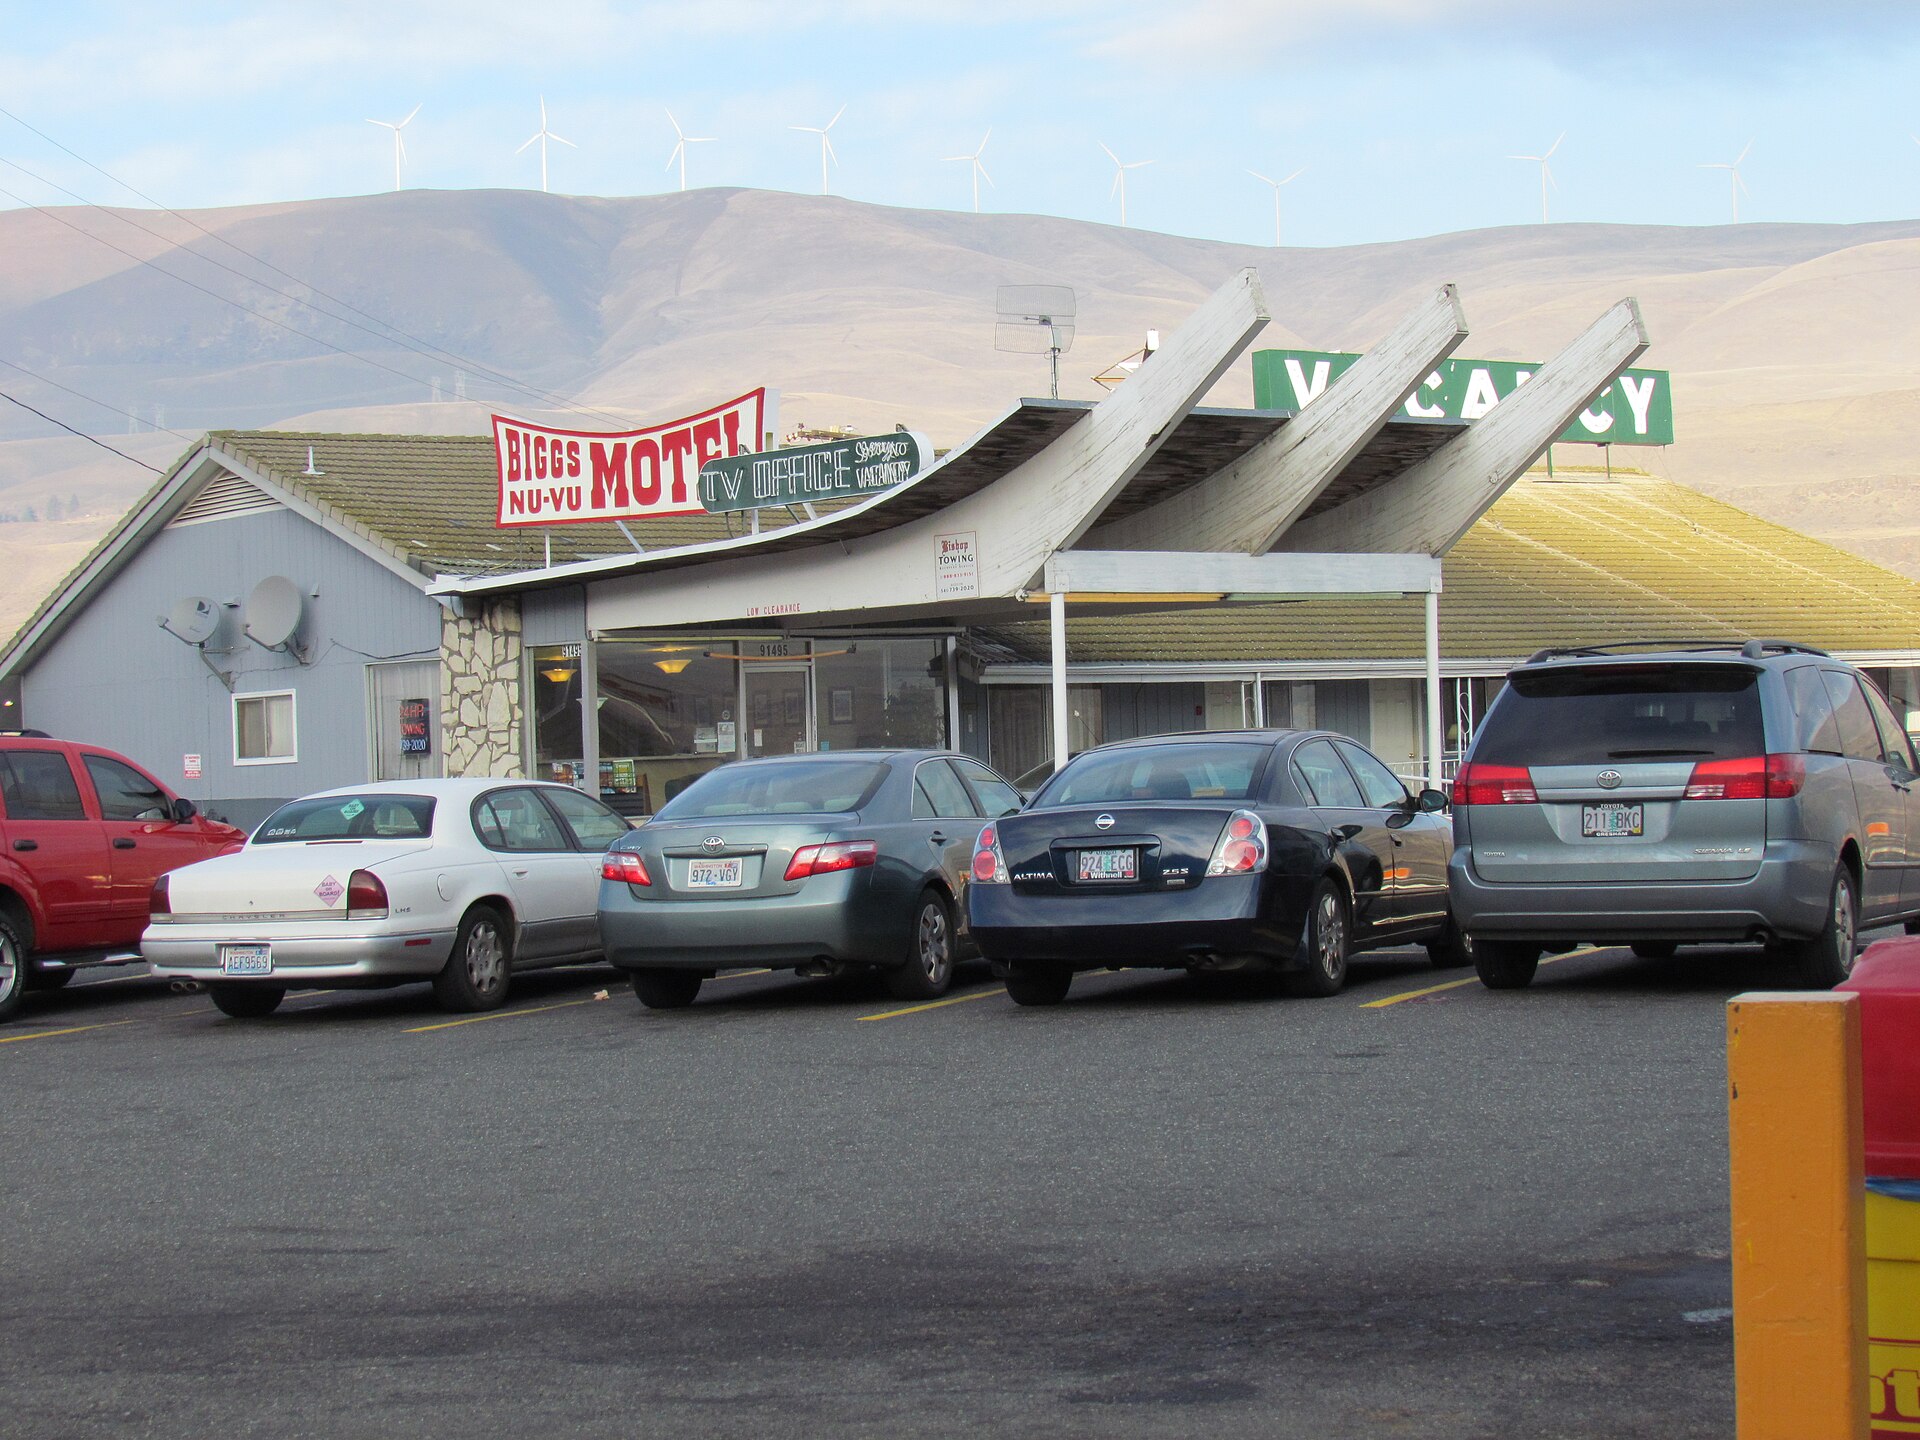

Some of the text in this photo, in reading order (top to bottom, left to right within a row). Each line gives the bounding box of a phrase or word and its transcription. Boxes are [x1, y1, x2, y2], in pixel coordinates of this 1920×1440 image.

[1284, 358, 1656, 435] VCACY
[505, 428, 581, 482] BIGGS
[702, 448, 851, 502] TV OFFICE
[509, 486, 582, 515] NU-VU
[941, 539, 969, 555] Bishop
[938, 554, 974, 566] TOWING
[746, 602, 801, 617] LOW CLEARANCE
[759, 644, 788, 657] 91495
[1585, 811, 1640, 829] 211 BKC
[1694, 847, 1733, 855] SIENNA
[1013, 872, 1054, 881] ALTIMA
[1090, 871, 1123, 879] Withnell
[395, 906, 411, 914] LHS
[228, 955, 268, 970] AEF9569
